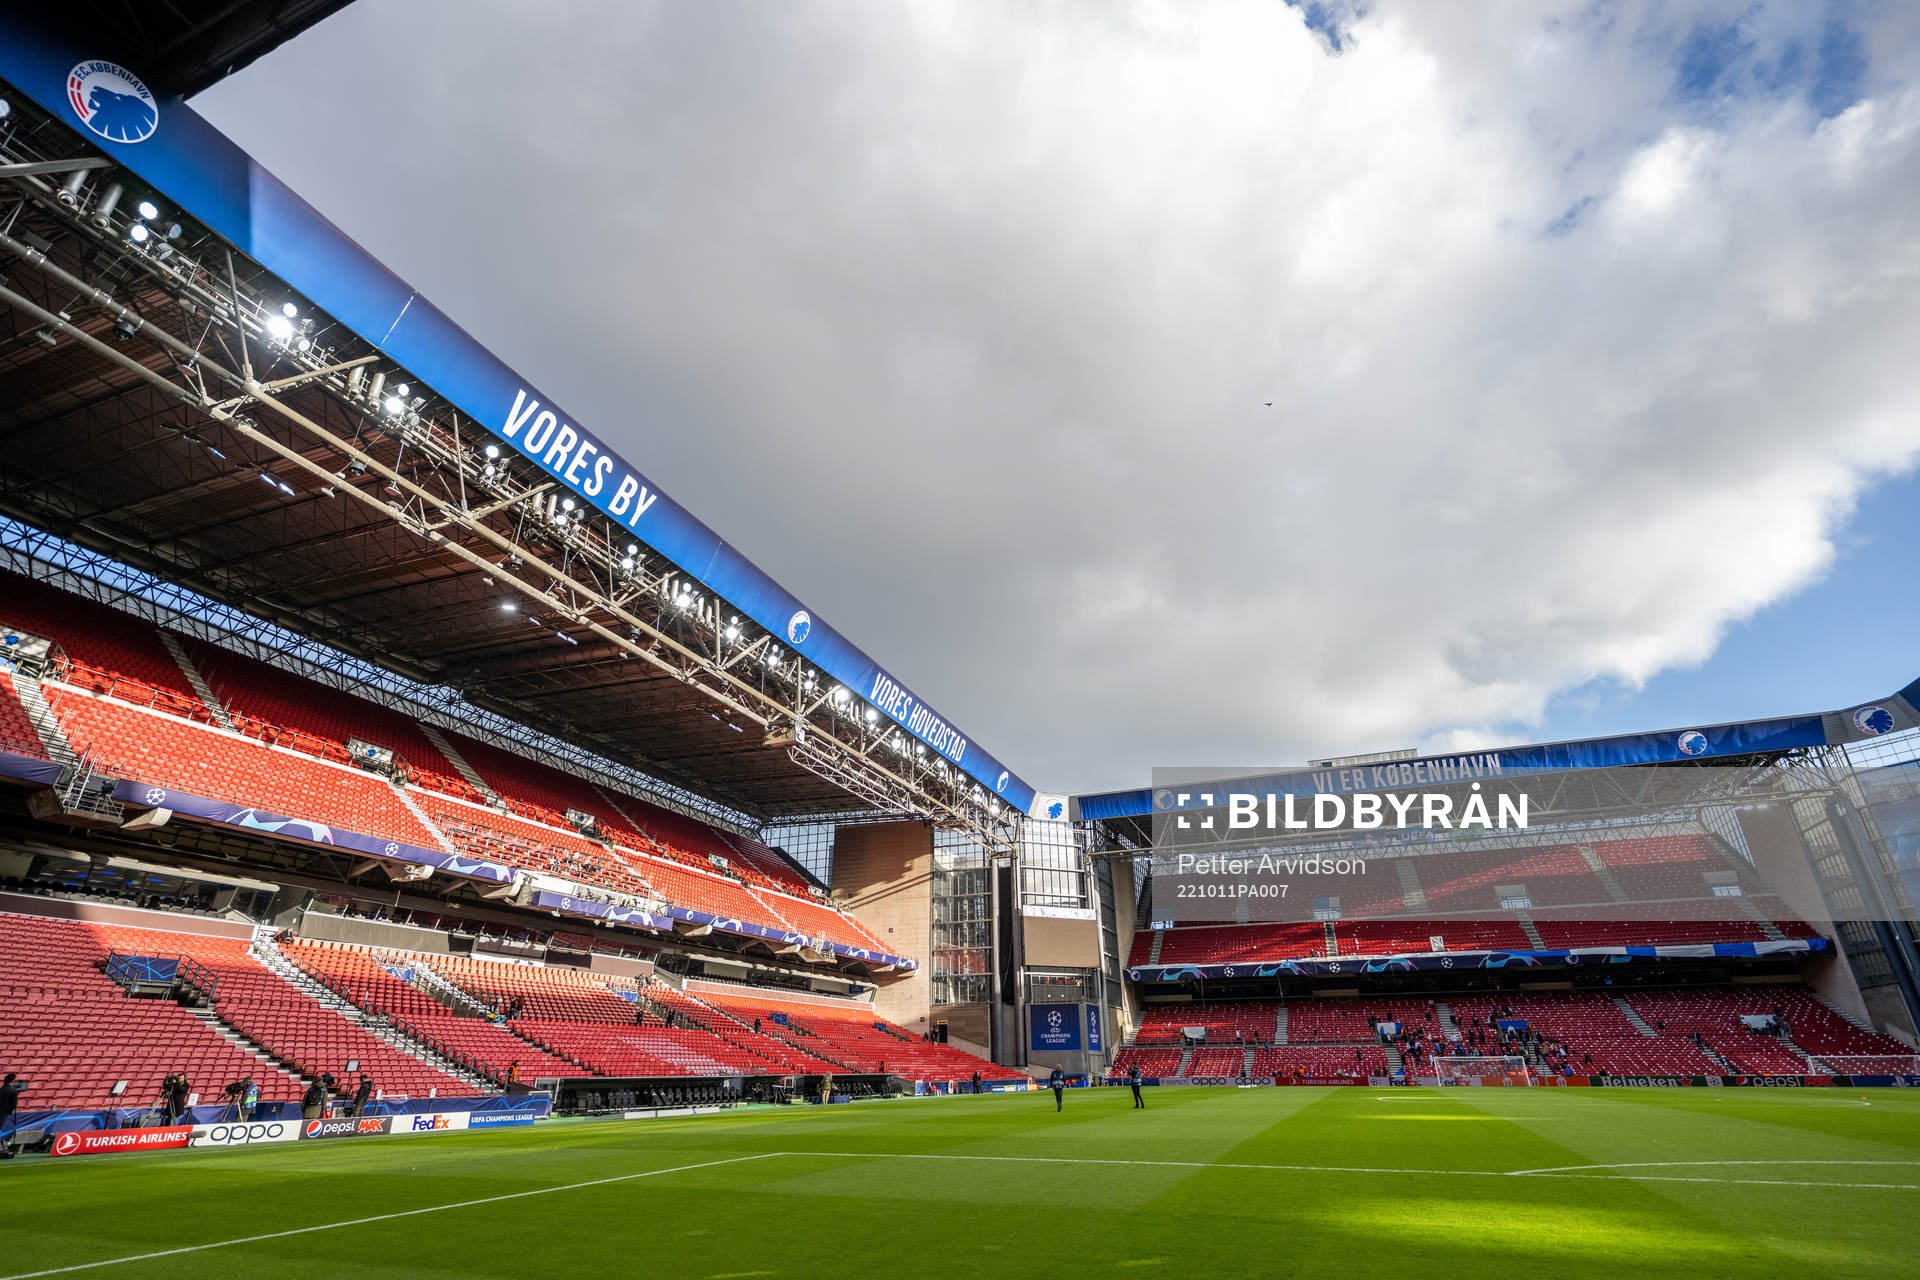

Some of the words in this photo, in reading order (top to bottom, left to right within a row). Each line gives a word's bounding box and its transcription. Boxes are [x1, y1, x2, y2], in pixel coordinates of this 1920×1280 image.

[88, 62, 150, 98] KØBENHAVN
[502, 388, 613, 496] VORES
[607, 473, 657, 528] BY
[870, 672, 913, 722] VORES
[907, 703, 967, 762] HOVEDSTAD
[1312, 771, 1334, 794] VI
[1340, 768, 1367, 791] ER
[1372, 753, 1502, 787] KØBENHAVN
[1401, 831, 1434, 841] UEFA
[1191, 1077, 1227, 1086] oppo
[1389, 1077, 1419, 1087] FedEx
[1600, 1076, 1679, 1088] Heineken
[1753, 1076, 1800, 1087] pepsi
[323, 1121, 355, 1136] pepsi
[357, 1118, 387, 1134] MAX
[412, 1114, 450, 1131] FedEx
[85, 1134, 136, 1148] TURKISH
[139, 1131, 188, 1144] AIRLINES
[210, 1124, 284, 1143] oppo
